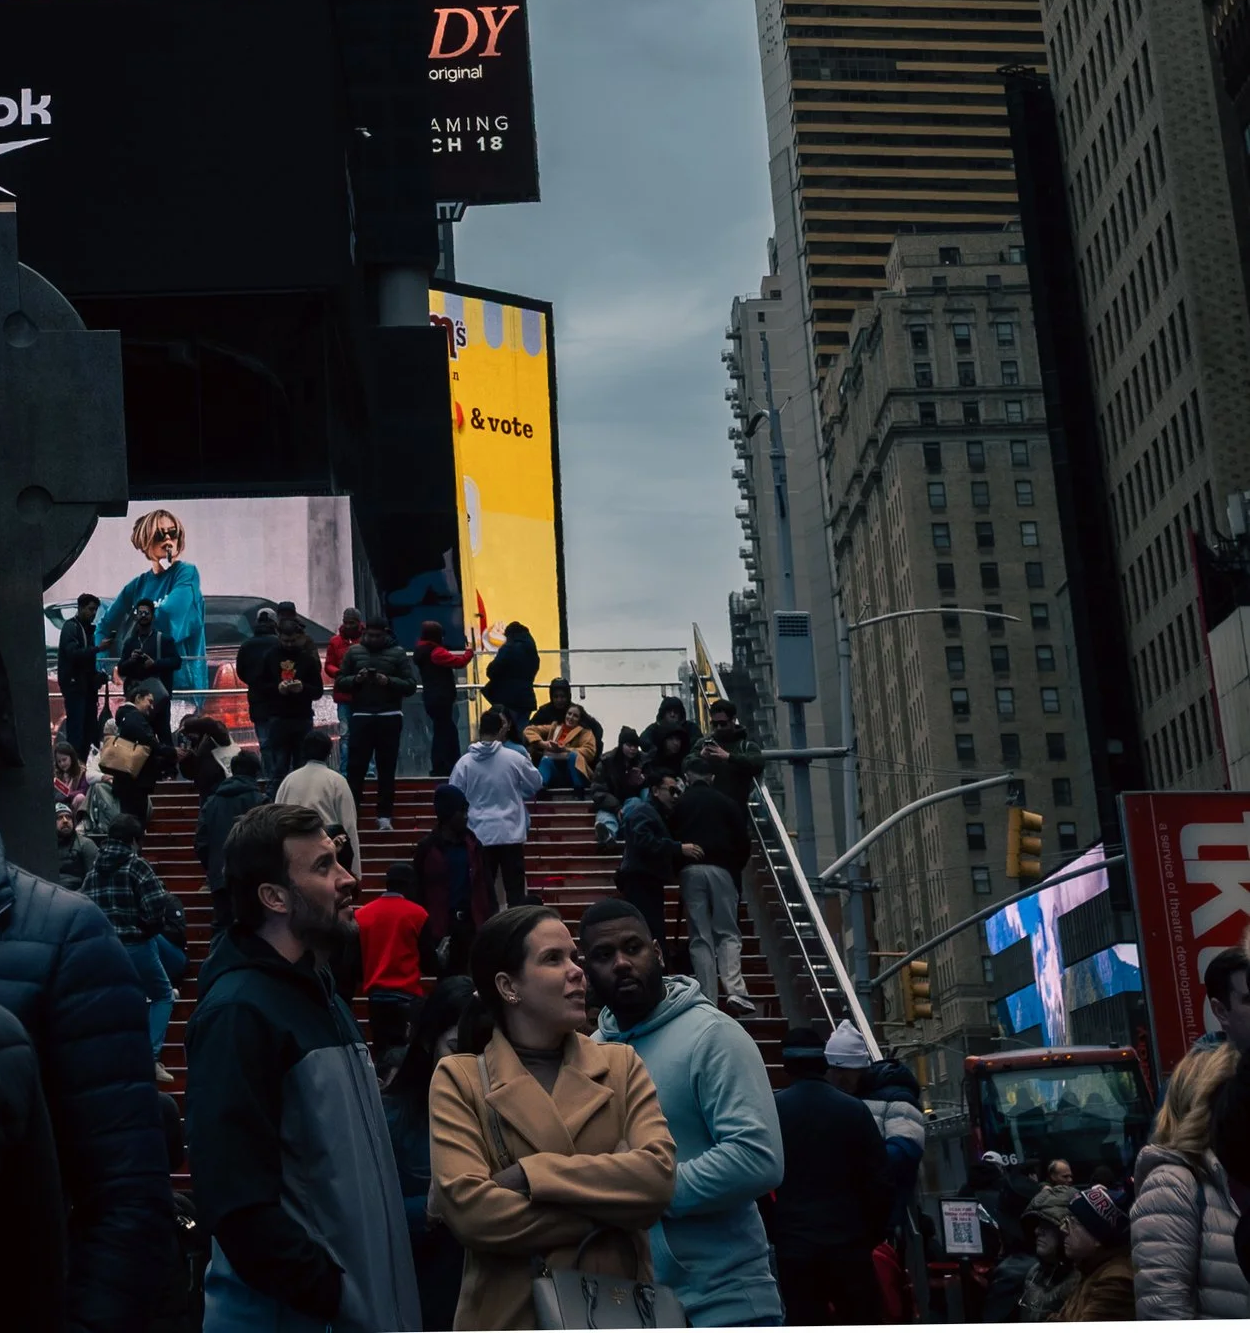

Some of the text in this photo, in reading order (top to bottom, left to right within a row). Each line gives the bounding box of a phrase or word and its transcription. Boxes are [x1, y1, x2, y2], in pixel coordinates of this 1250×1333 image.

[428, 64, 483, 82] original
[476, 136, 503, 151] 18
[471, 407, 534, 439] & vote
[1158, 823, 1168, 831] a
[1159, 833, 1175, 879] service
[1168, 880, 1180, 896] of
[1169, 896, 1184, 942] theatre
[1175, 943, 1197, 1029] development
